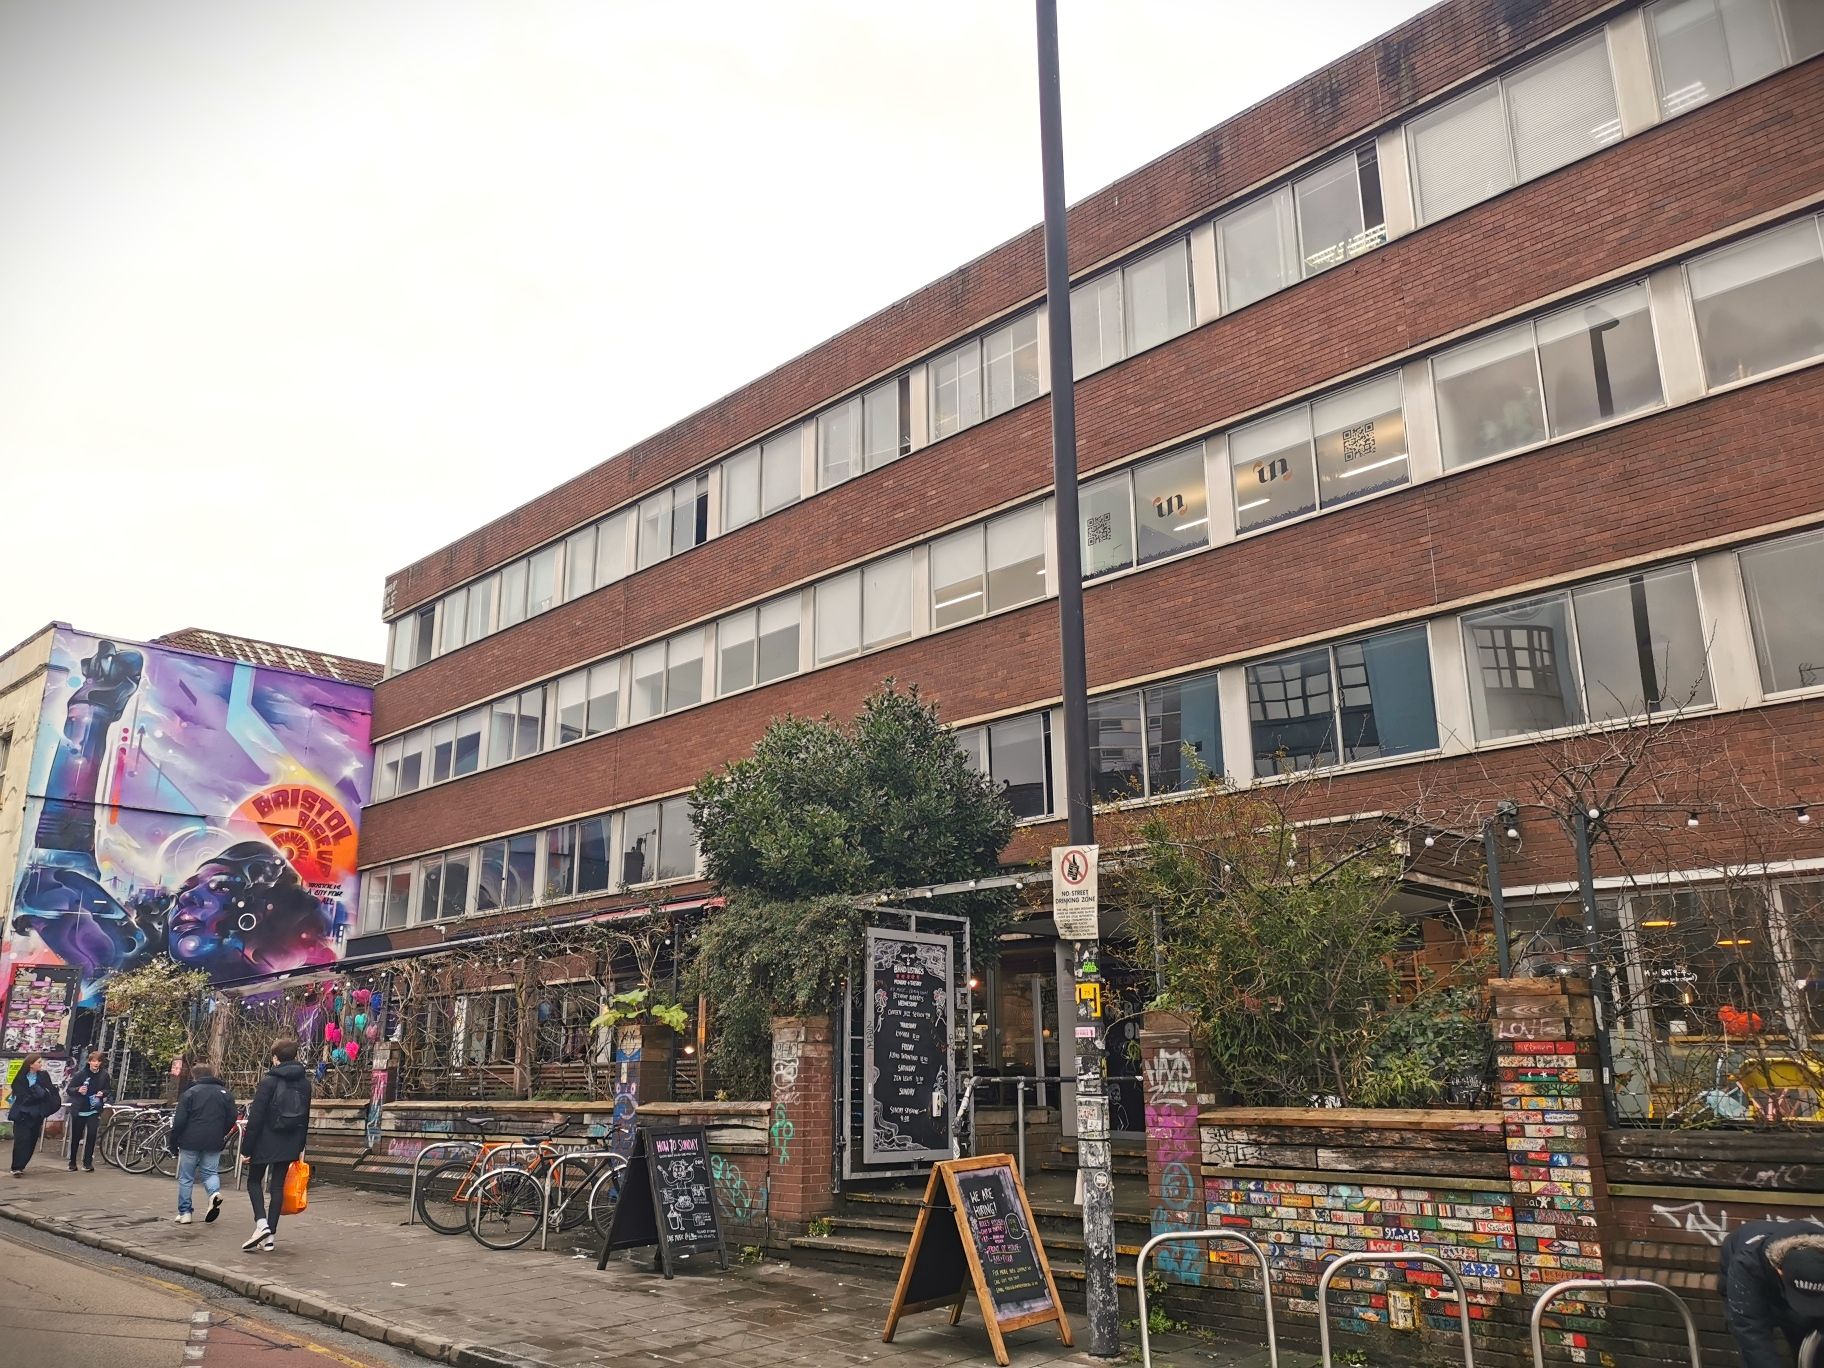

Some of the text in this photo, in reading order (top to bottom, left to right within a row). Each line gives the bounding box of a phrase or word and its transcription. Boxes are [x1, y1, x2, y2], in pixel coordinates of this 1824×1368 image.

[252, 788, 352, 846] BRISTOL
[297, 810, 334, 878] RISE UP
[656, 1137, 699, 1153] HOW TO SUNDAY
[969, 1187, 994, 1203] WE ARE
[973, 1201, 998, 1217] HIRING!
[1369, 1240, 1397, 1251] LOVE
